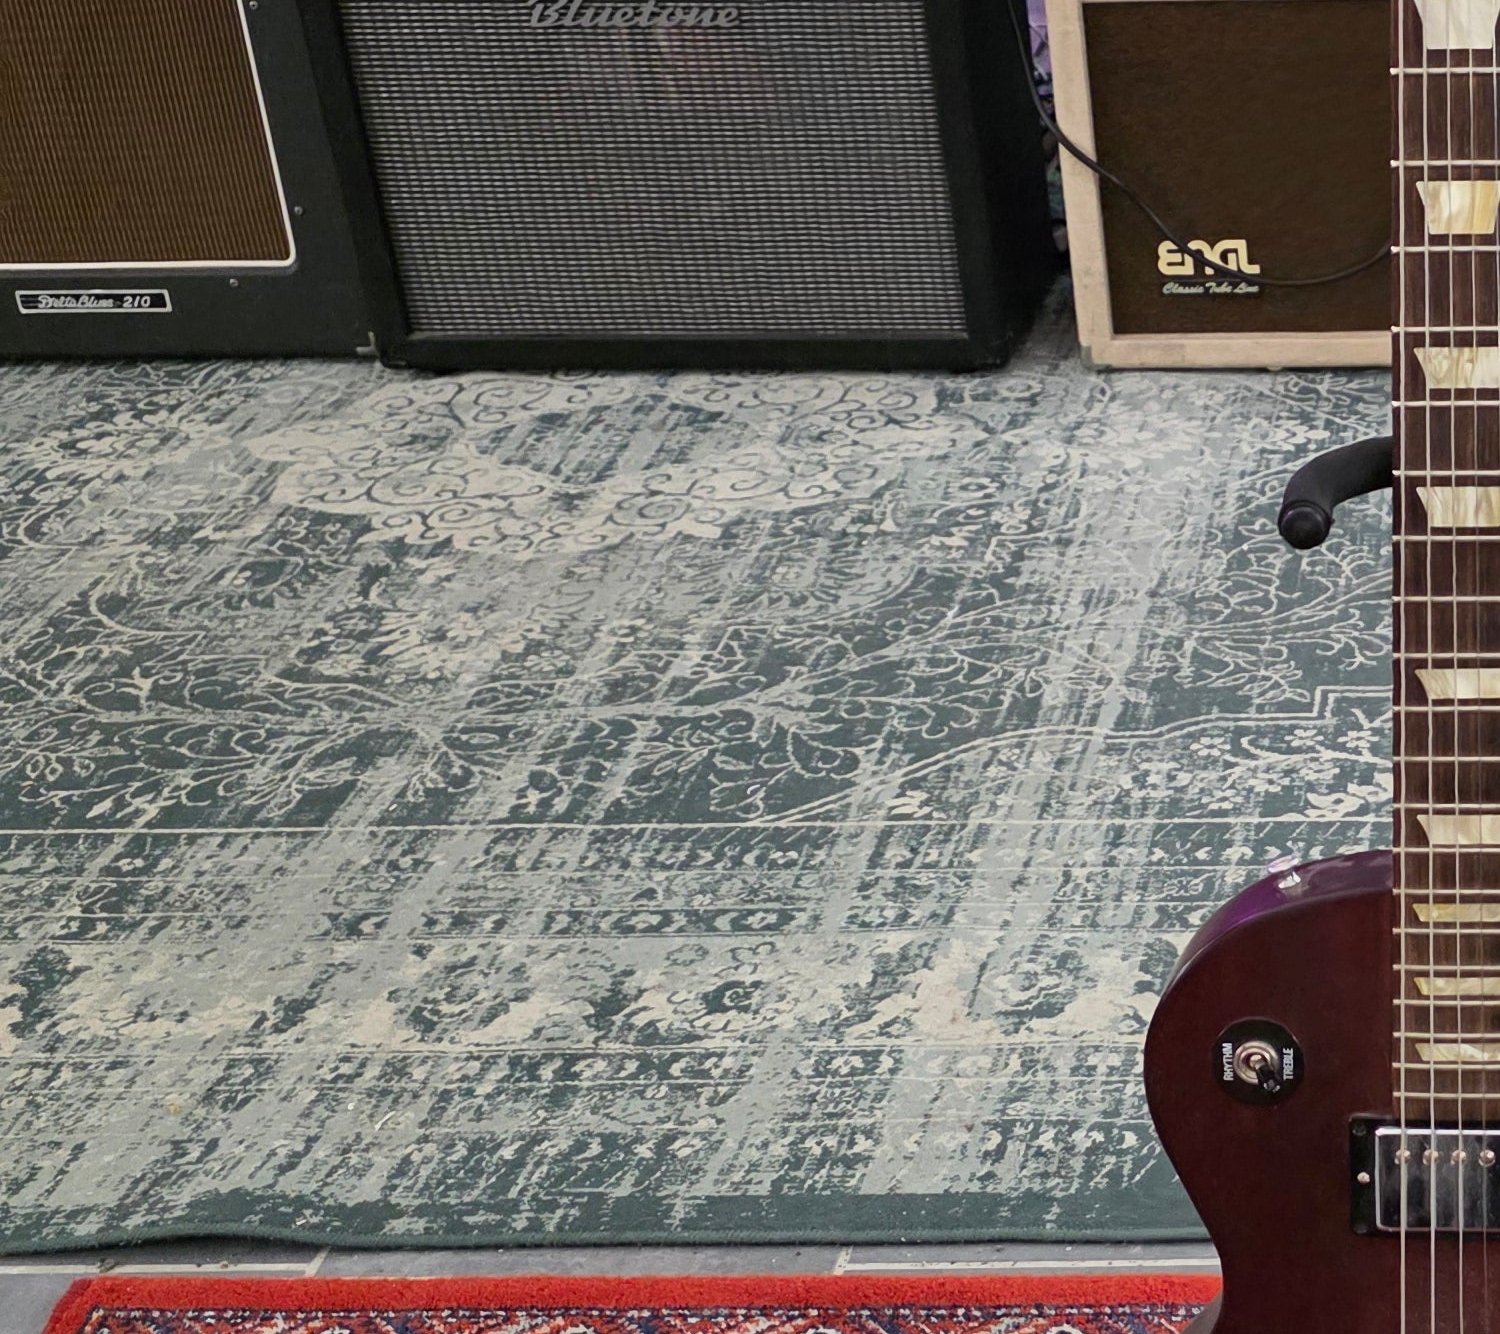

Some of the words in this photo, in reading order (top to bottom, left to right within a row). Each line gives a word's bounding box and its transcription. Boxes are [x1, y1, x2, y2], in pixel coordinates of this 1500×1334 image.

[1158, 239, 1260, 275] ENGL
[122, 295, 151, 308] 210
[1162, 281, 1205, 294] Classic
[1222, 1042, 1234, 1081] RHYTHM
[1282, 1047, 1294, 1080] TREBLE
